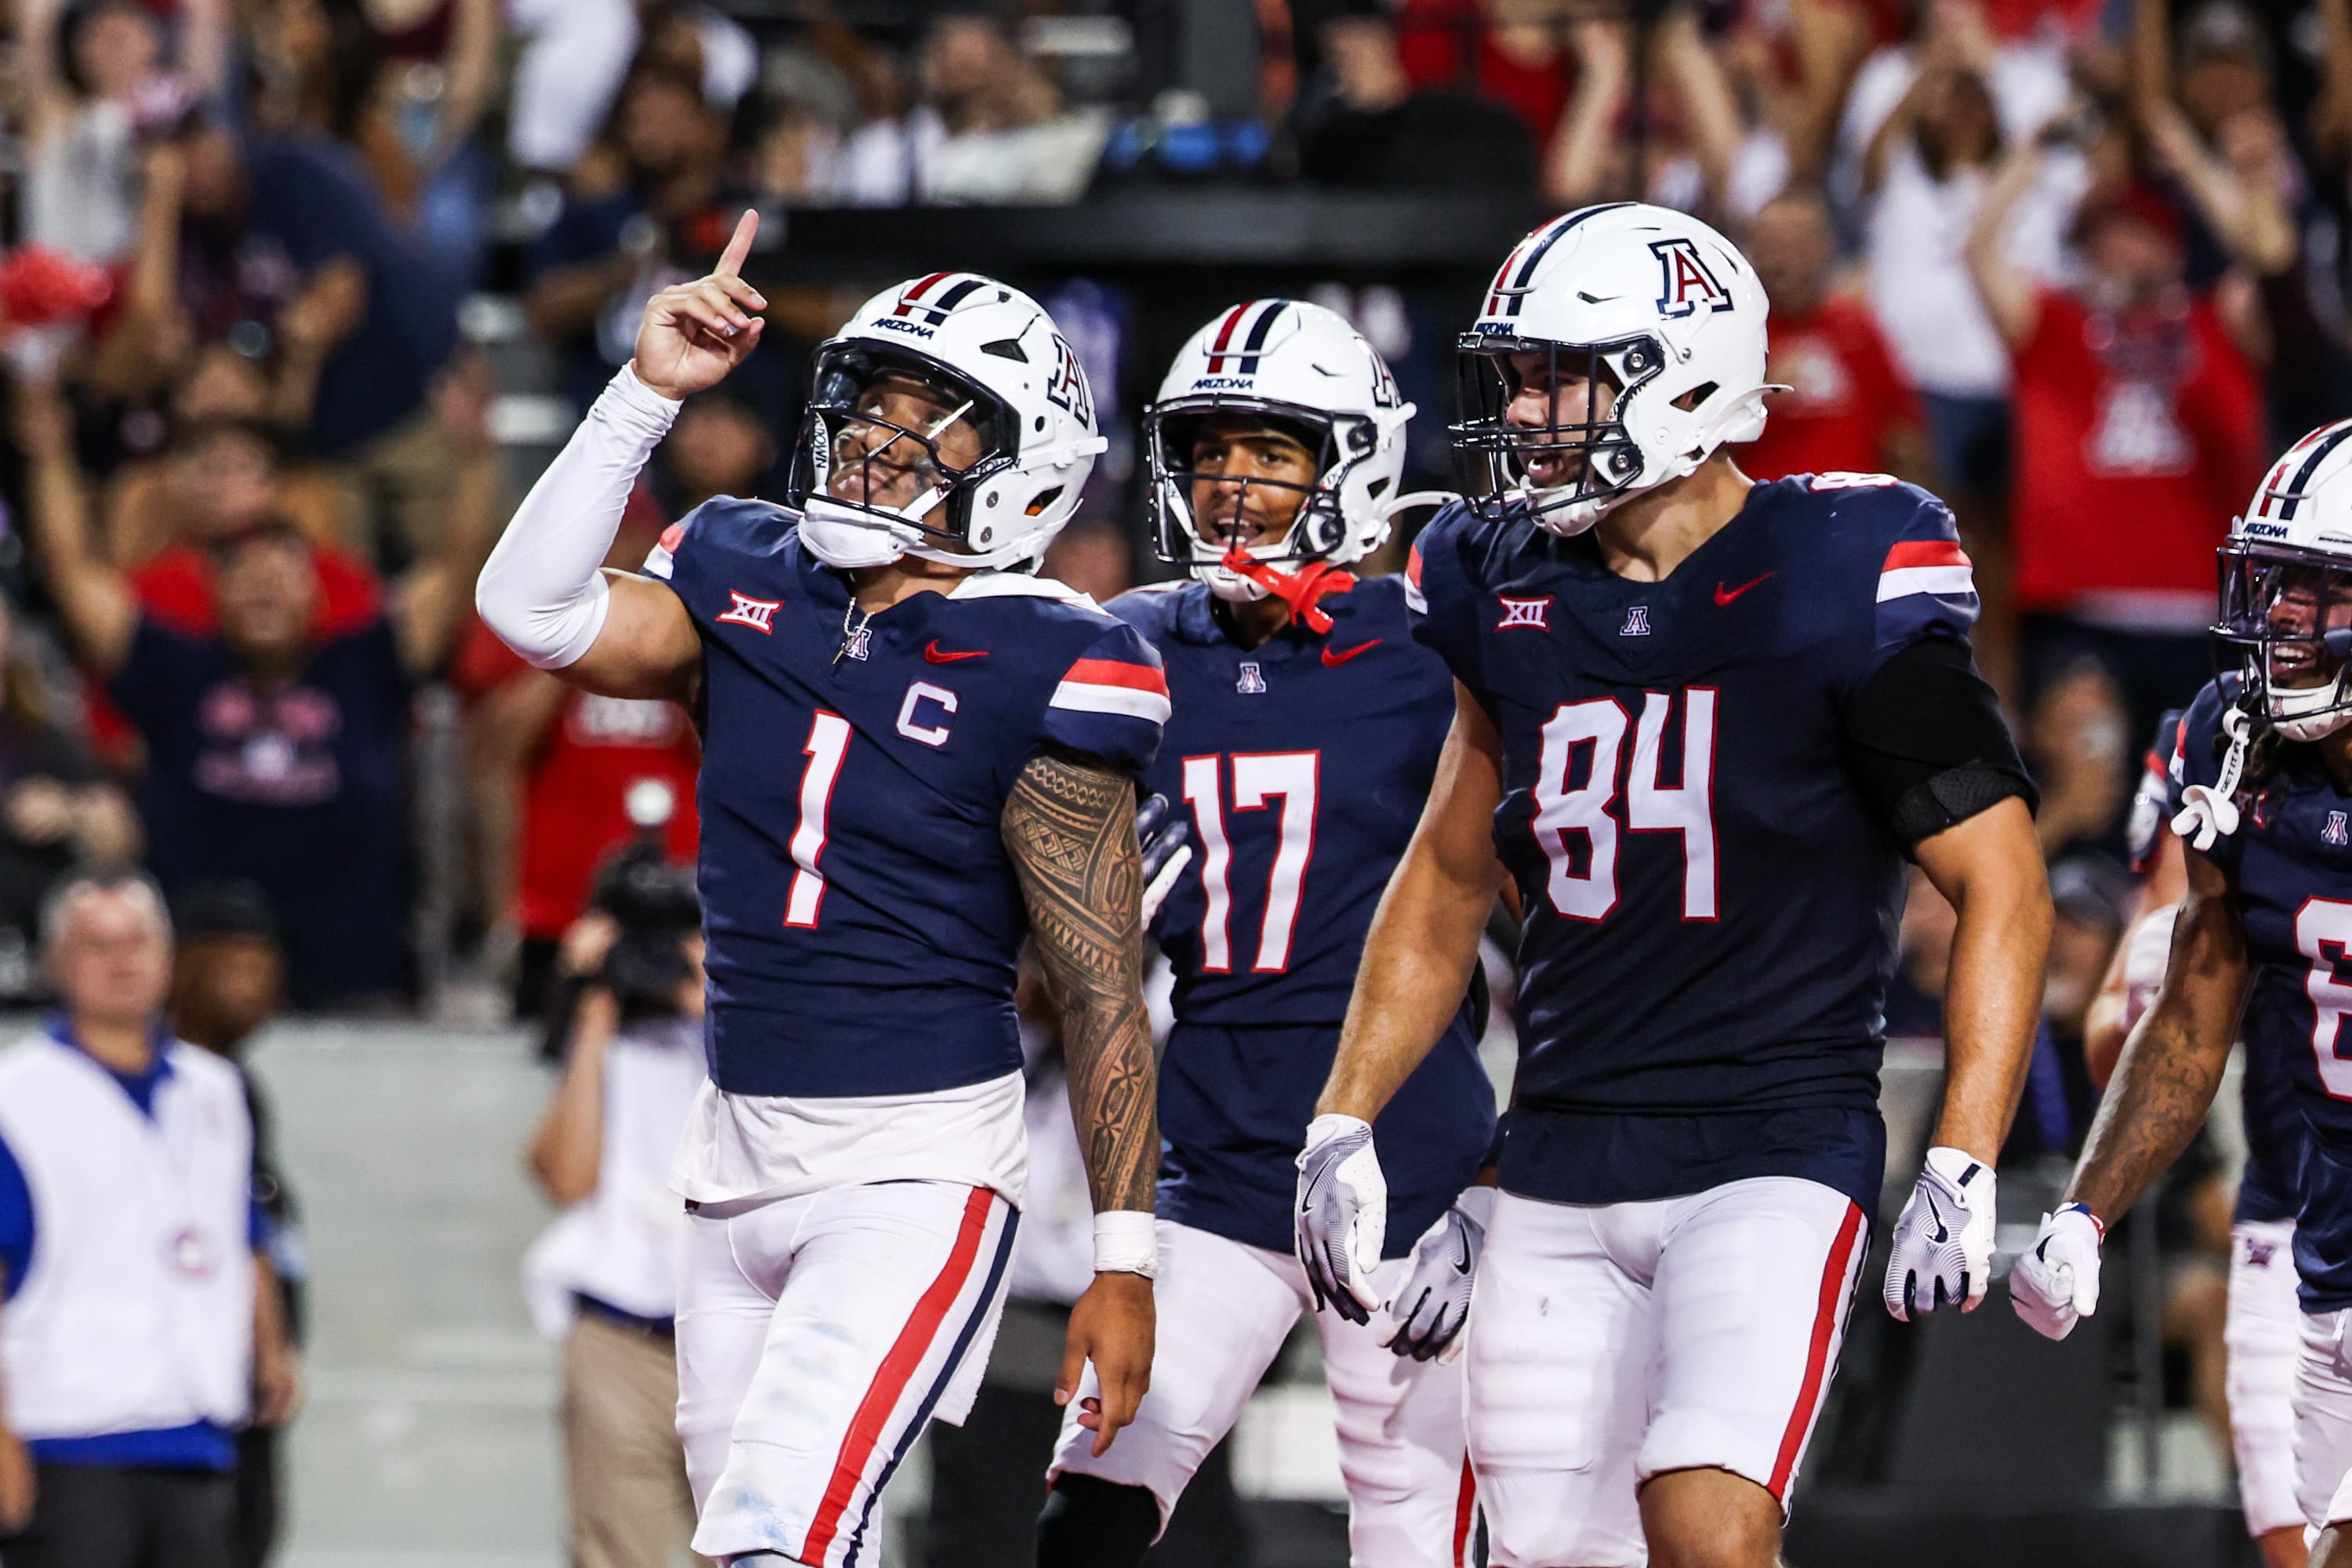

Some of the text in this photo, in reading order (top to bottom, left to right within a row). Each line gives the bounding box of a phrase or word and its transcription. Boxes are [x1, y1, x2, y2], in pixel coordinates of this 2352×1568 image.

[1646, 238, 1735, 321] A
[869, 318, 935, 340] ARIZONA
[1047, 332, 1090, 430] A
[1190, 378, 1254, 390] ARIZONA
[2243, 522, 2288, 539] ARIZONA
[1496, 595, 1553, 631] XII
[1620, 605, 1650, 636] A
[842, 626, 872, 661] A
[1236, 662, 1267, 694] A
[896, 681, 958, 746] C
[784, 709, 854, 929] 1
[1530, 685, 1720, 924] 84
[2321, 810, 2348, 846] A
[1181, 750, 1321, 973] 17
